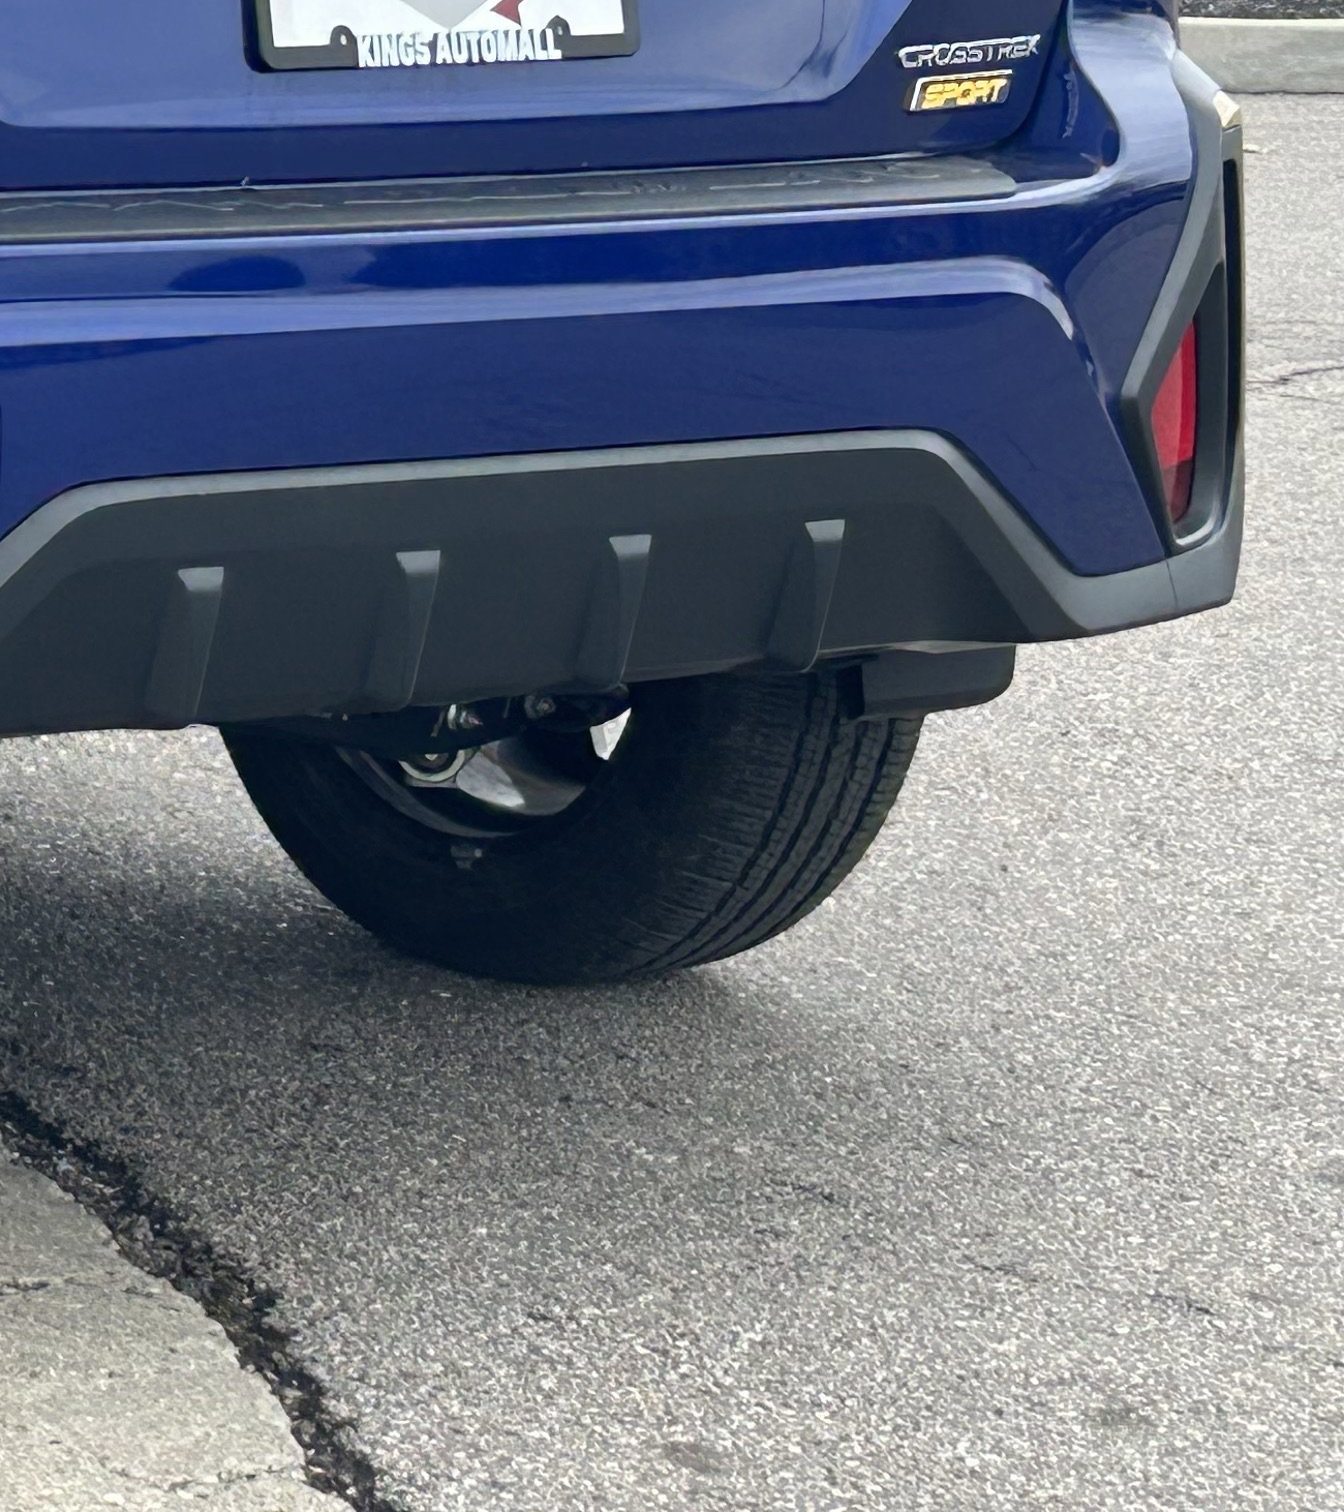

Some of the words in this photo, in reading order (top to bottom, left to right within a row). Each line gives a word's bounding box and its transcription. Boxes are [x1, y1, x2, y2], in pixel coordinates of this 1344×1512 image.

[356, 32, 431, 68] KINGS
[435, 28, 562, 65] AUTOMALL
[897, 34, 1041, 68] CROSSTREK
[921, 78, 1008, 109] SPORT
